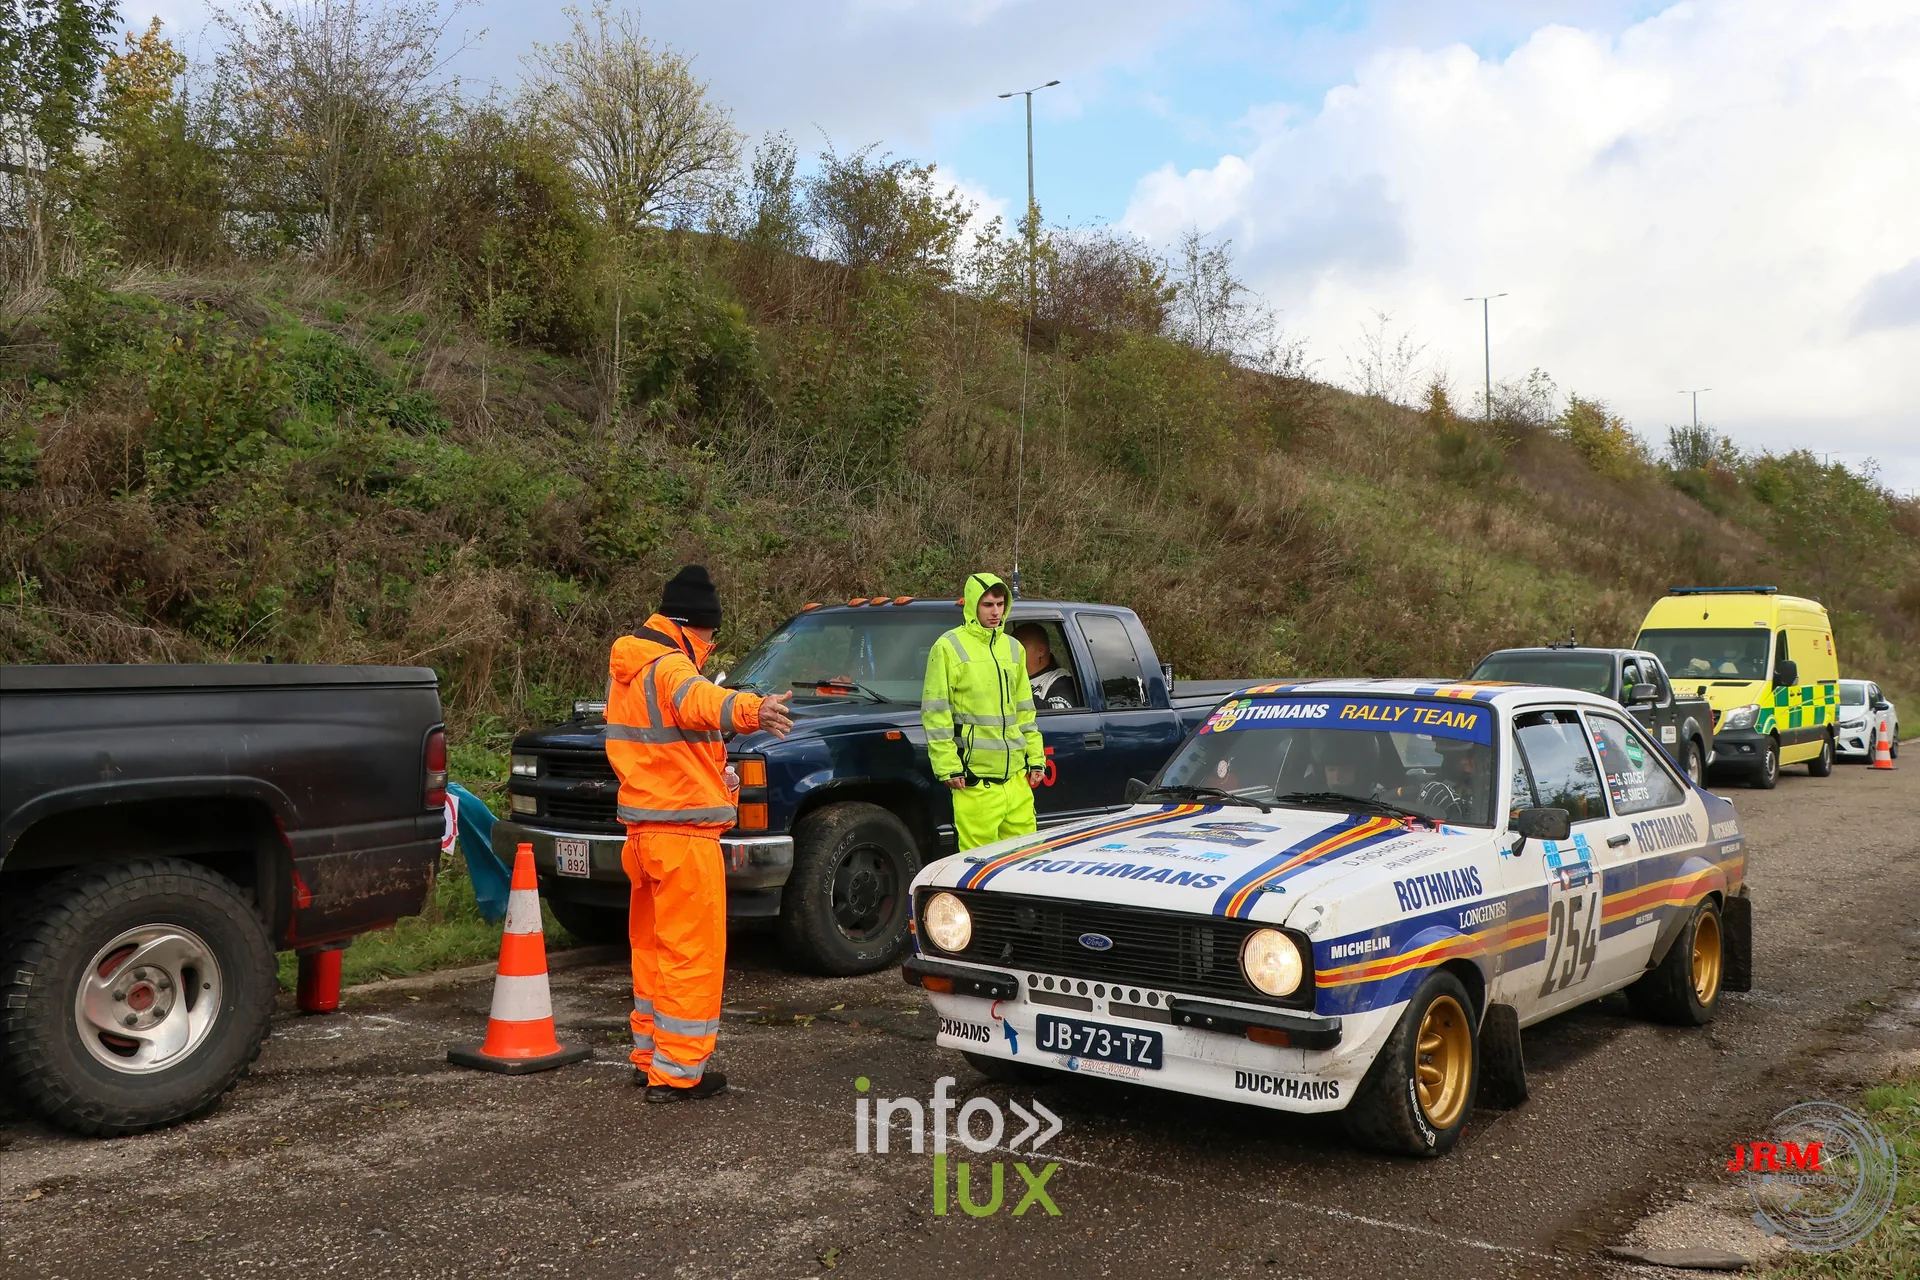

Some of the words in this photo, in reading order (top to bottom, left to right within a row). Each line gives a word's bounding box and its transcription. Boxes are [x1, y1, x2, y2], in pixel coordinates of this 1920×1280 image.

[1340, 704, 1409, 721] RALLY
[1413, 708, 1477, 730] TEAM
[1614, 773, 1623, 786] G.
[1624, 771, 1646, 785] STACEY
[1622, 790, 1628, 802] E.
[1628, 787, 1649, 801] SMETS
[1631, 812, 1698, 853] ROTHMANS
[568, 860, 585, 872] 892
[1017, 859, 1226, 889] ROTHMANS
[1393, 865, 1483, 912] ROTHMANS
[1459, 901, 1507, 929] LONGINES
[1086, 936, 1105, 947] Ford
[1331, 936, 1391, 959] MICHELIN
[1538, 892, 1597, 999] 254
[1042, 1021, 1153, 1064] JB-73-TZ
[1080, 1059, 1140, 1078] SERVICE-WORLD.NL
[1235, 1070, 1339, 1101] DUCKHAMS
